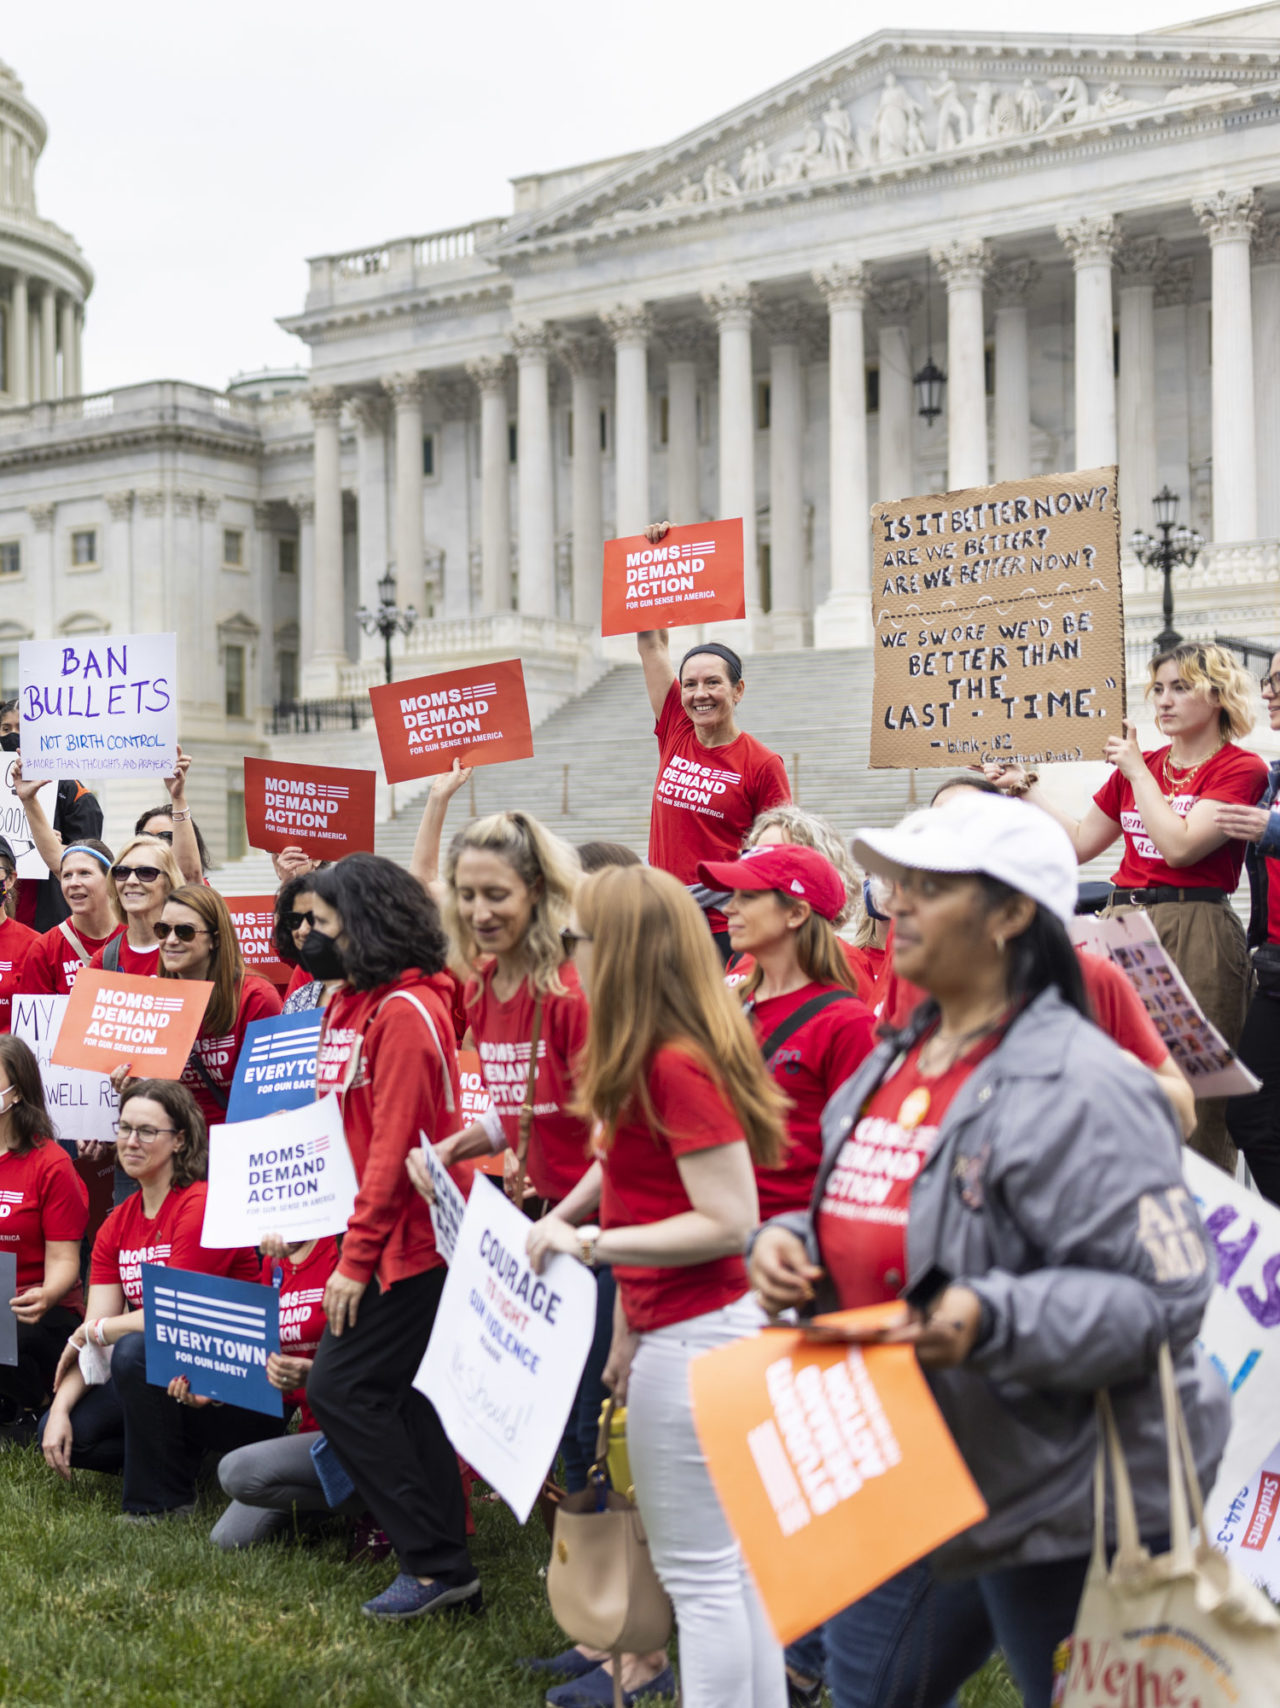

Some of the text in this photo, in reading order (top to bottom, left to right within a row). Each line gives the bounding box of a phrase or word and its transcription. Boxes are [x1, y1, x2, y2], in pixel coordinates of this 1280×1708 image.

[916, 511, 948, 537] IT
[951, 496, 1033, 534] BETTER
[1034, 486, 1110, 517] NOW?
[626, 545, 681, 567] MOMS
[883, 525, 1051, 569] ARE WE BETTER?
[626, 558, 705, 584] DEMAND
[882, 544, 1097, 597] ARE WE BETTER NOW?
[625, 575, 694, 599] ACTION
[626, 590, 716, 610] FOR GUN SENSE IN AMERICA
[881, 611, 1094, 648] WE SWORE WE'D BE
[61, 644, 128, 679] BAN
[909, 636, 1082, 677] BETTER THAN
[948, 674, 1008, 700] THE
[23, 679, 170, 722] BULLETS
[400, 688, 462, 713] MOMS
[403, 700, 489, 729] DEMAND
[884, 701, 955, 731] LAST
[40, 733, 166, 751] NOT BIRTH CONTROL
[407, 718, 481, 745] ACTION
[410, 731, 503, 756] FOR GUN SENSE IN AMERICA
[26, 757, 173, 772] #MORE THAN THOUGHTS AND PRAYERS
[669, 755, 711, 777] MOMS
[264, 777, 317, 796] MOMS
[657, 780, 712, 806] ACTION
[662, 767, 727, 794] DEMAND
[264, 794, 339, 815] DEMAND
[264, 809, 328, 829] ACTION
[264, 824, 348, 841] FOR GUN SENSE IN AMERICA
[96, 988, 155, 1010] MOMS
[14, 999, 56, 1042] MY
[91, 1004, 171, 1029] DEMAND
[86, 1021, 158, 1044] ACTION
[83, 1036, 168, 1056] FOR GUN SENSE IN AMERICA
[46, 1082, 88, 1107] WELL
[257, 1082, 290, 1095] FOR GUN
[248, 1143, 306, 1168] MOMS
[248, 1156, 326, 1186] DEMAND
[247, 1178, 319, 1204] ACTION
[479, 1228, 563, 1326] COURAGE
[156, 1323, 268, 1367] EVERYTOWN
[175, 1350, 248, 1379] FOR GUN SAFETY
